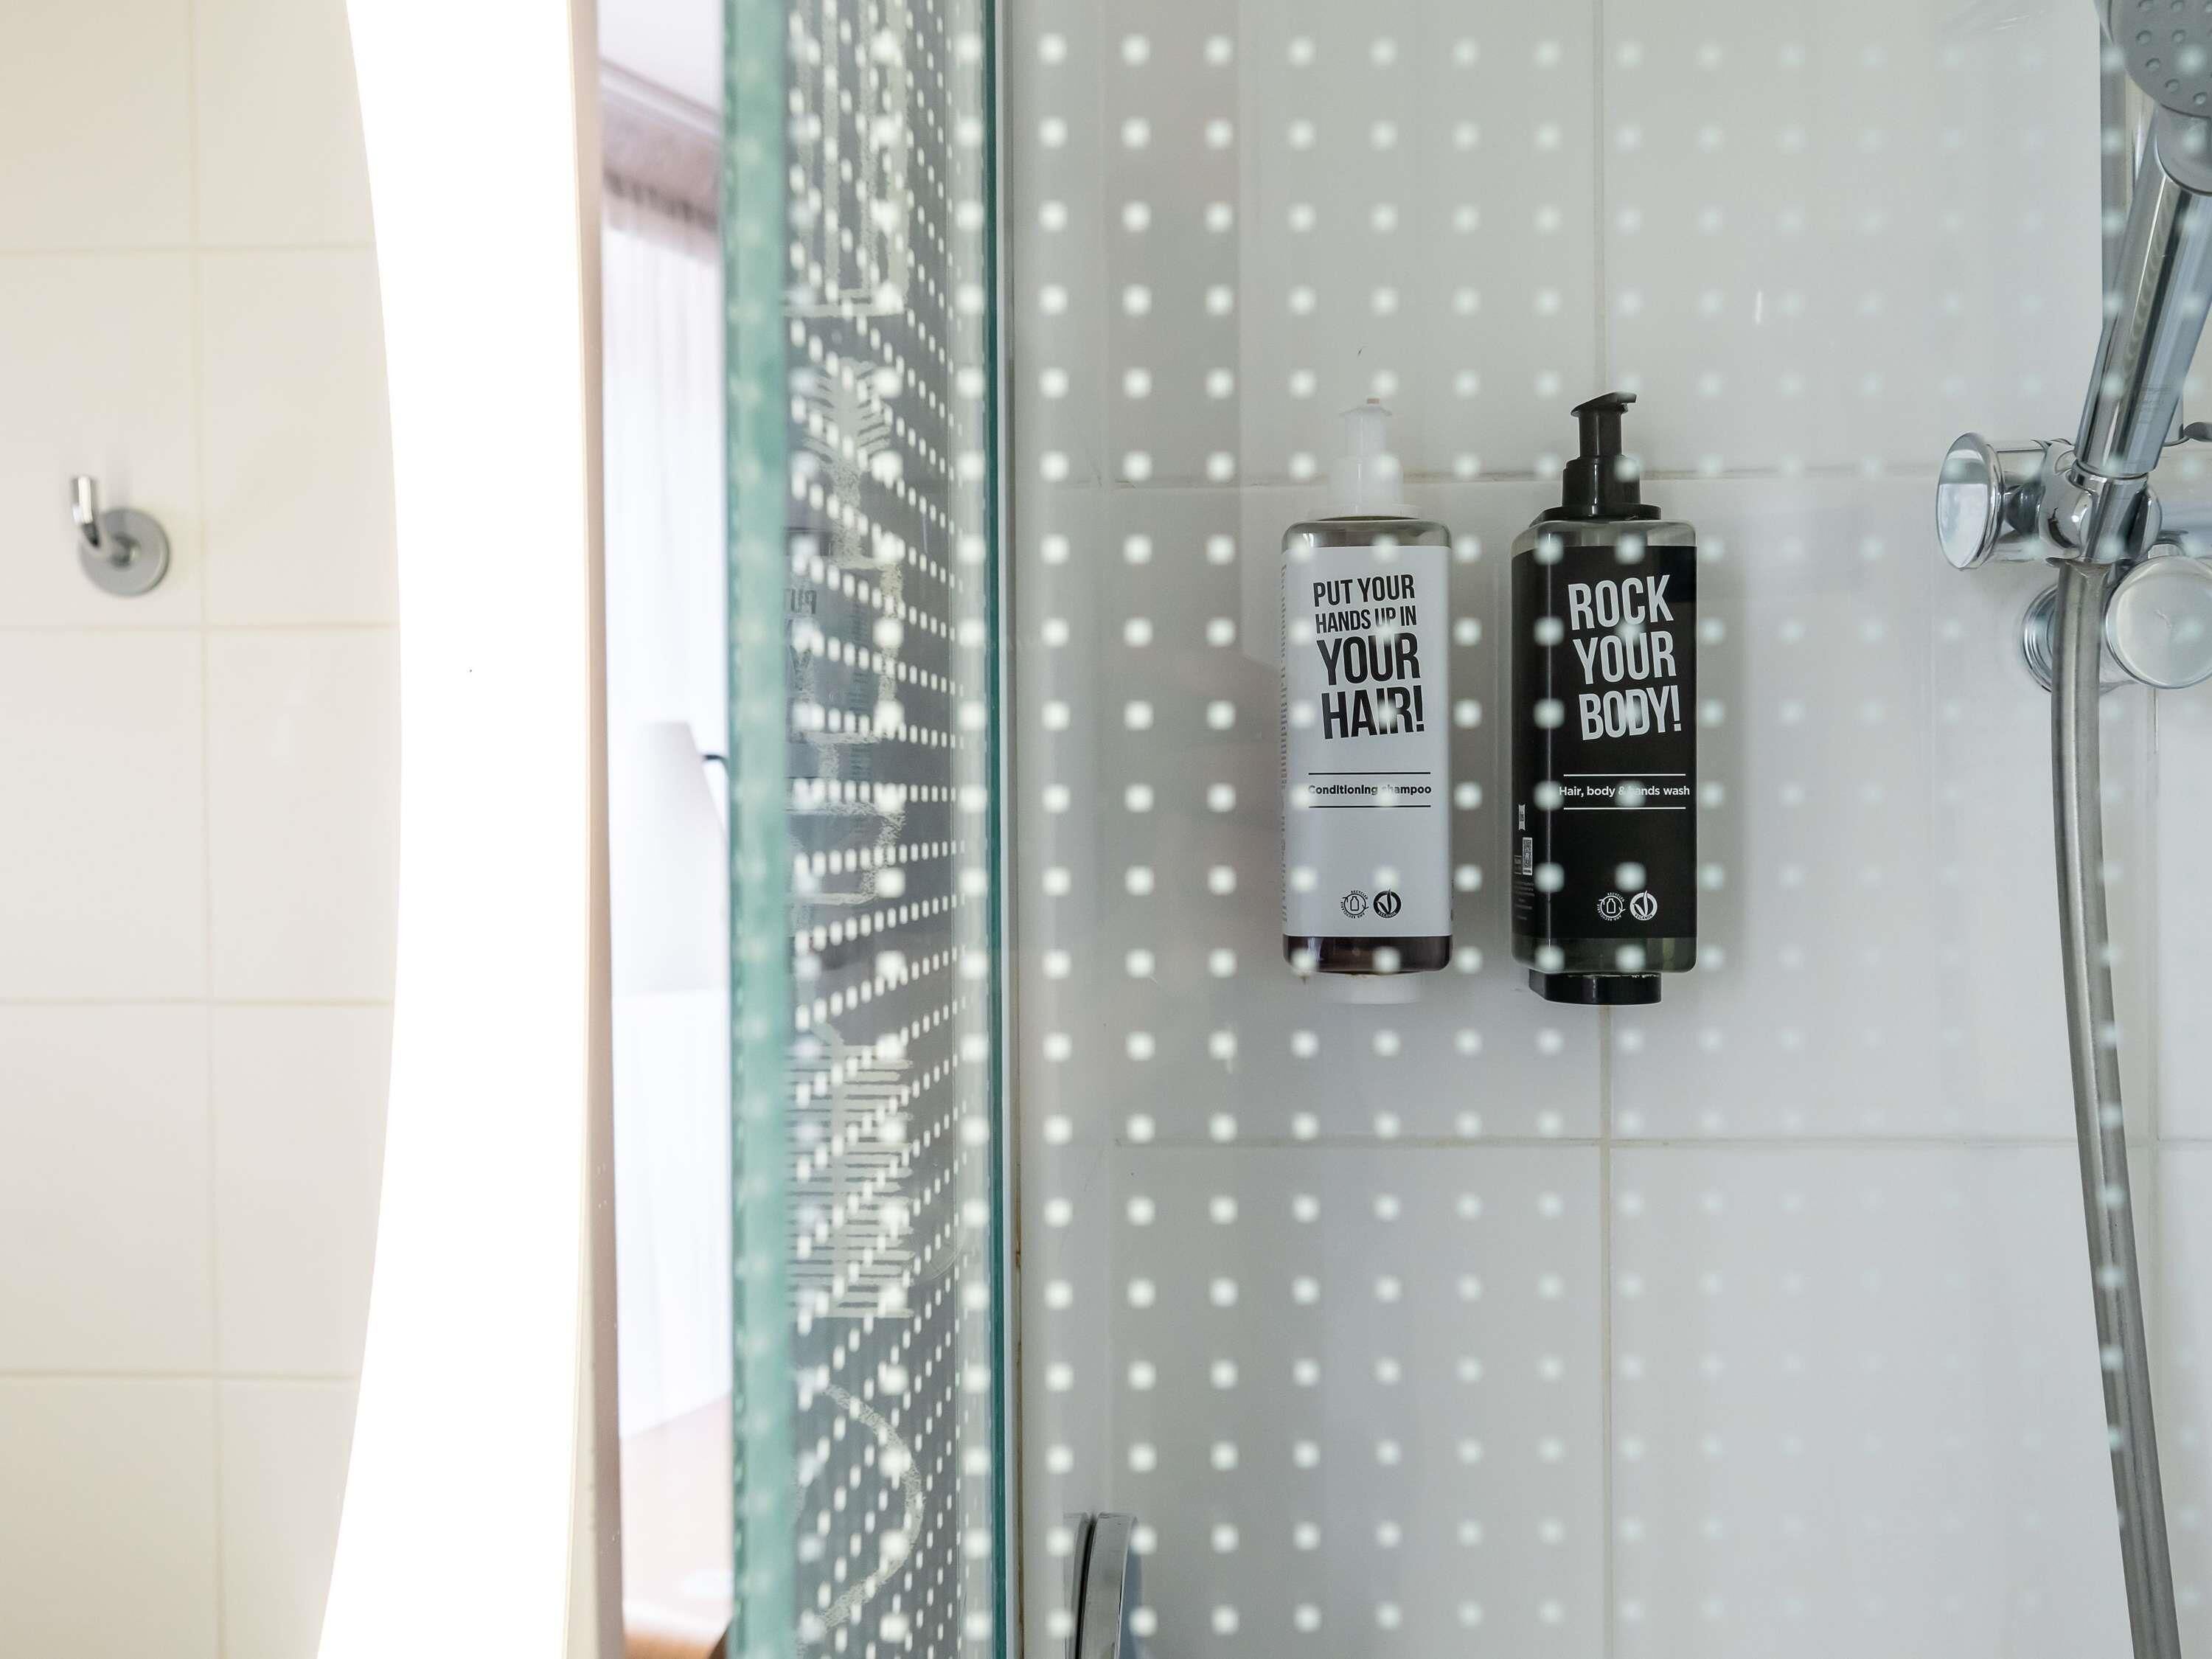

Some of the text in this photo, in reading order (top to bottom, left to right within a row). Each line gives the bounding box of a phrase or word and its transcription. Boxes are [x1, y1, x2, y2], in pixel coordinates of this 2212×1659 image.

[1313, 574, 1415, 607] PUT YOUR
[1568, 574, 1674, 630] ROCK
[1315, 605, 1417, 633] HANDS UP IN
[1316, 633, 1421, 686] YOUR
[1573, 630, 1677, 685] YOUR
[1321, 685, 1425, 740] HAIR!
[1579, 684, 1682, 741] BODY!
[1308, 784, 1378, 796] Conditioning
[1559, 787, 1585, 798] Hair,
[1587, 787, 1615, 798] body
[1618, 786, 1628, 796] &
[1663, 786, 1690, 796] wash
